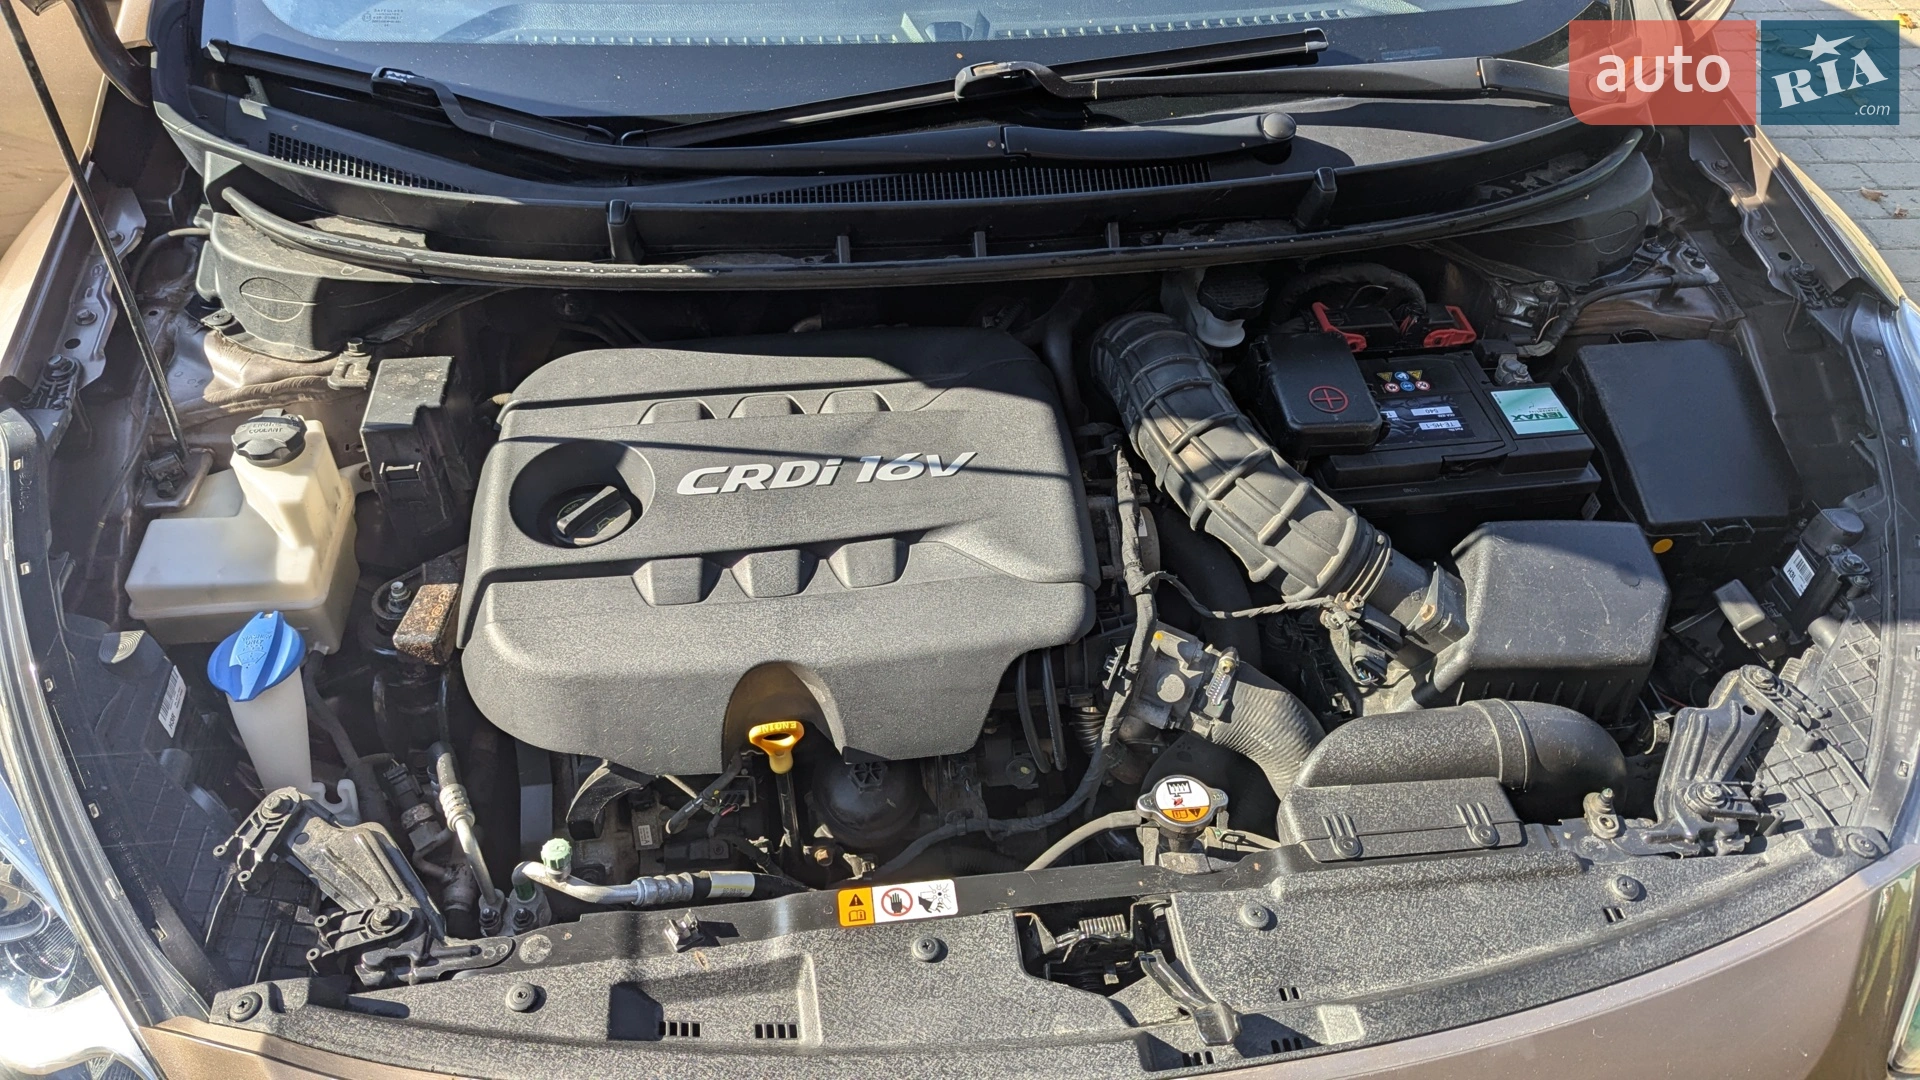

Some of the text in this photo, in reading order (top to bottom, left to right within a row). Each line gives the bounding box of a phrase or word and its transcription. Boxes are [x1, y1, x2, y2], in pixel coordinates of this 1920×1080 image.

[1511, 412, 1568, 422] TENAX
[676, 458, 843, 495] CRDi
[856, 451, 979, 484] 16V
